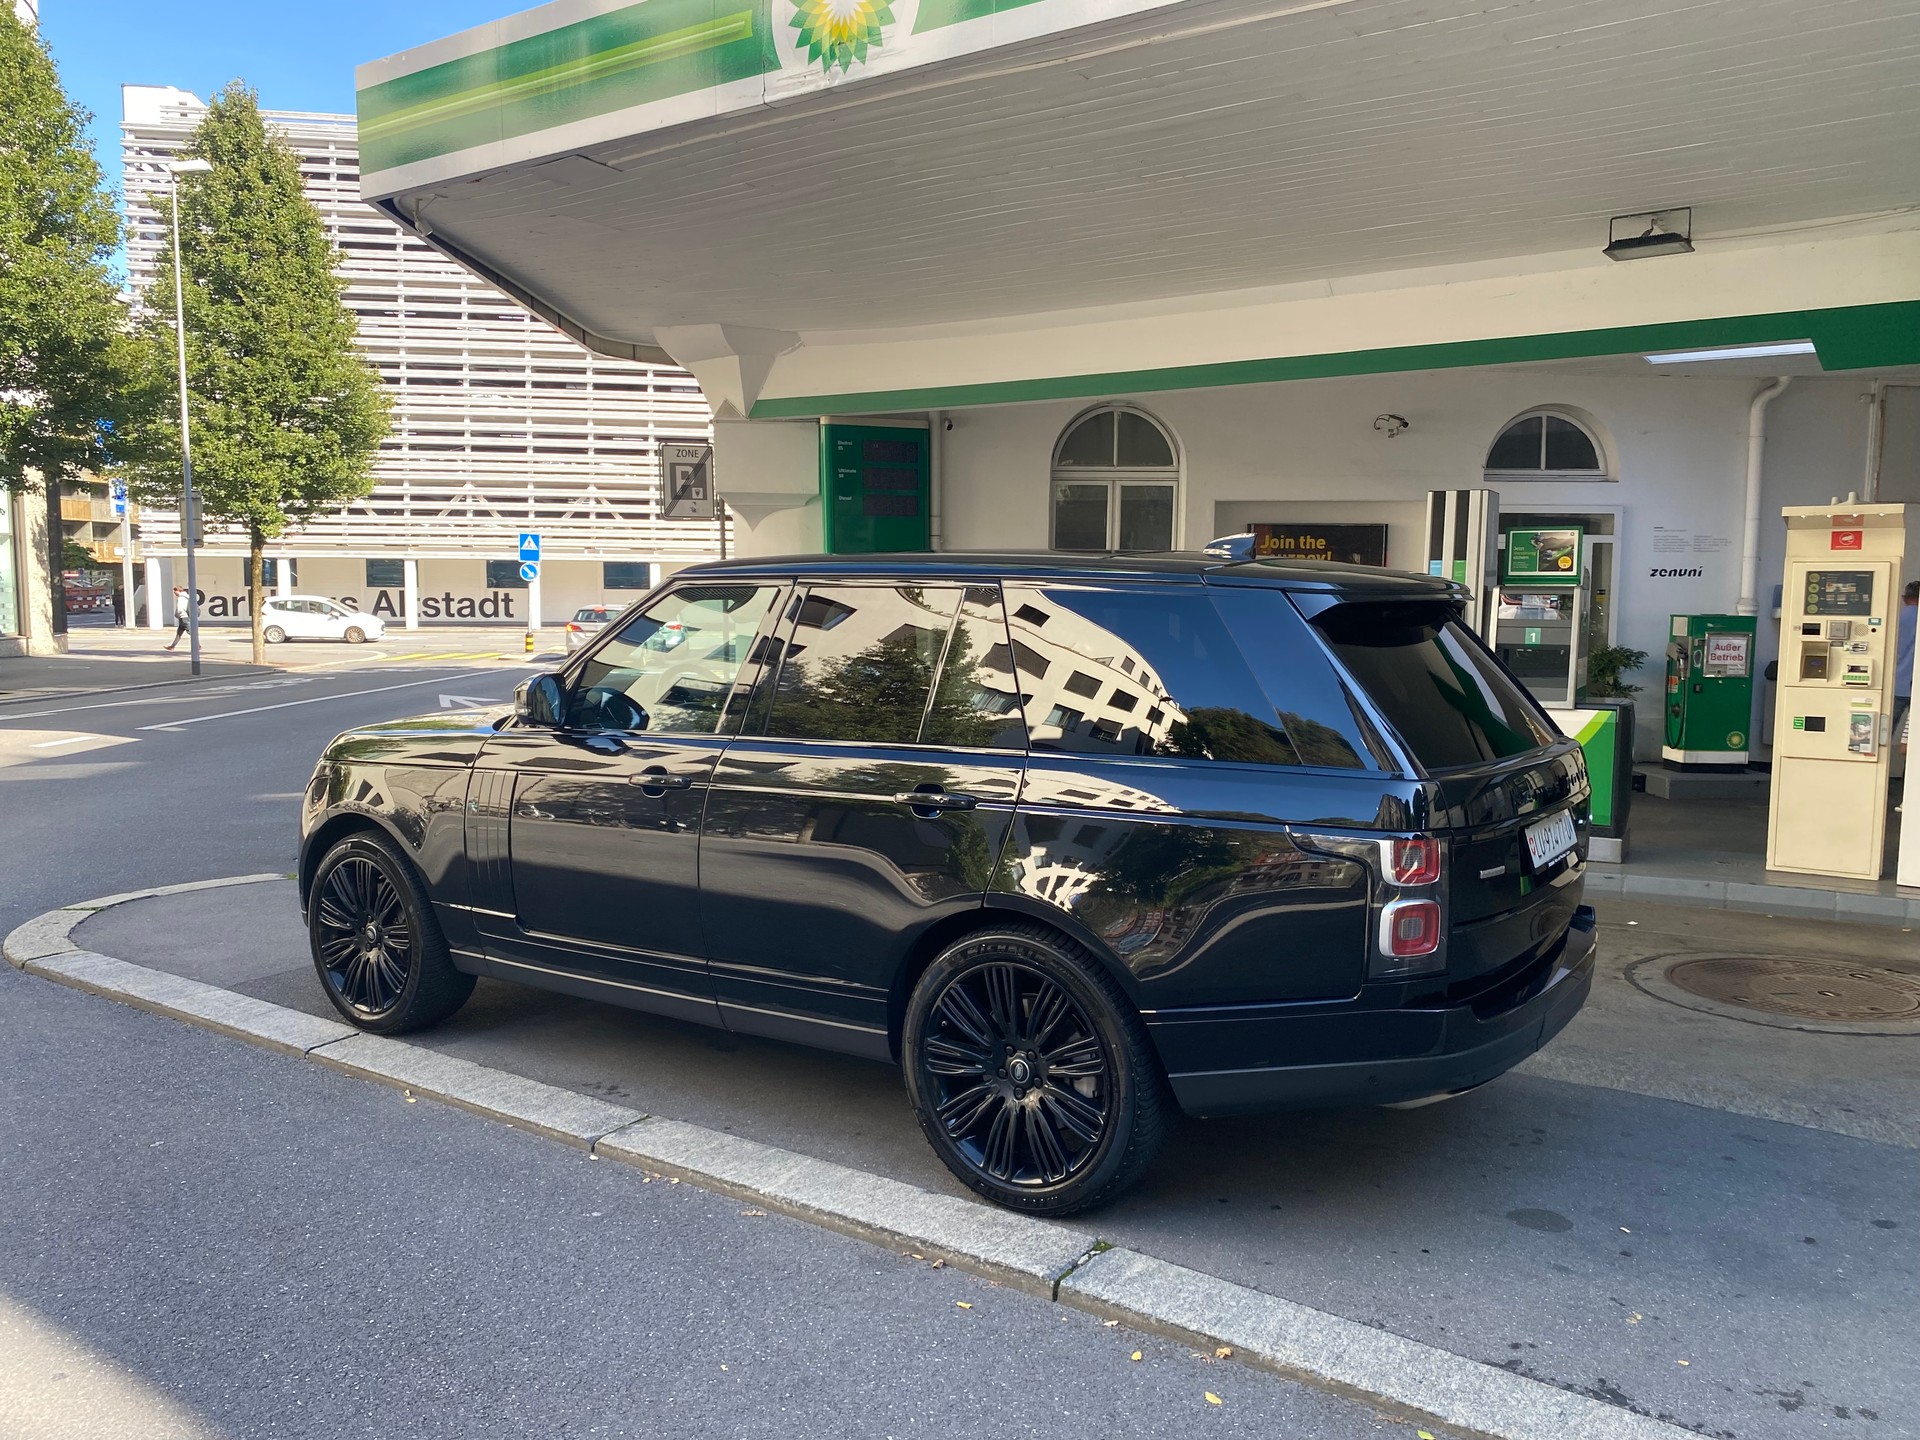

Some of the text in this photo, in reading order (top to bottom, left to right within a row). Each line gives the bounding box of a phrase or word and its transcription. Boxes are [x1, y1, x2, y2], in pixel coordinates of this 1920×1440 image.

[676, 449, 699, 458] ZONE
[1260, 535, 1326, 550] Join the
[1649, 566, 1704, 577] zenuni
[372, 589, 515, 618] Alstadt
[1529, 632, 1537, 643] 1
[1714, 643, 1742, 652] Außer
[1710, 653, 1744, 662] Betrieb
